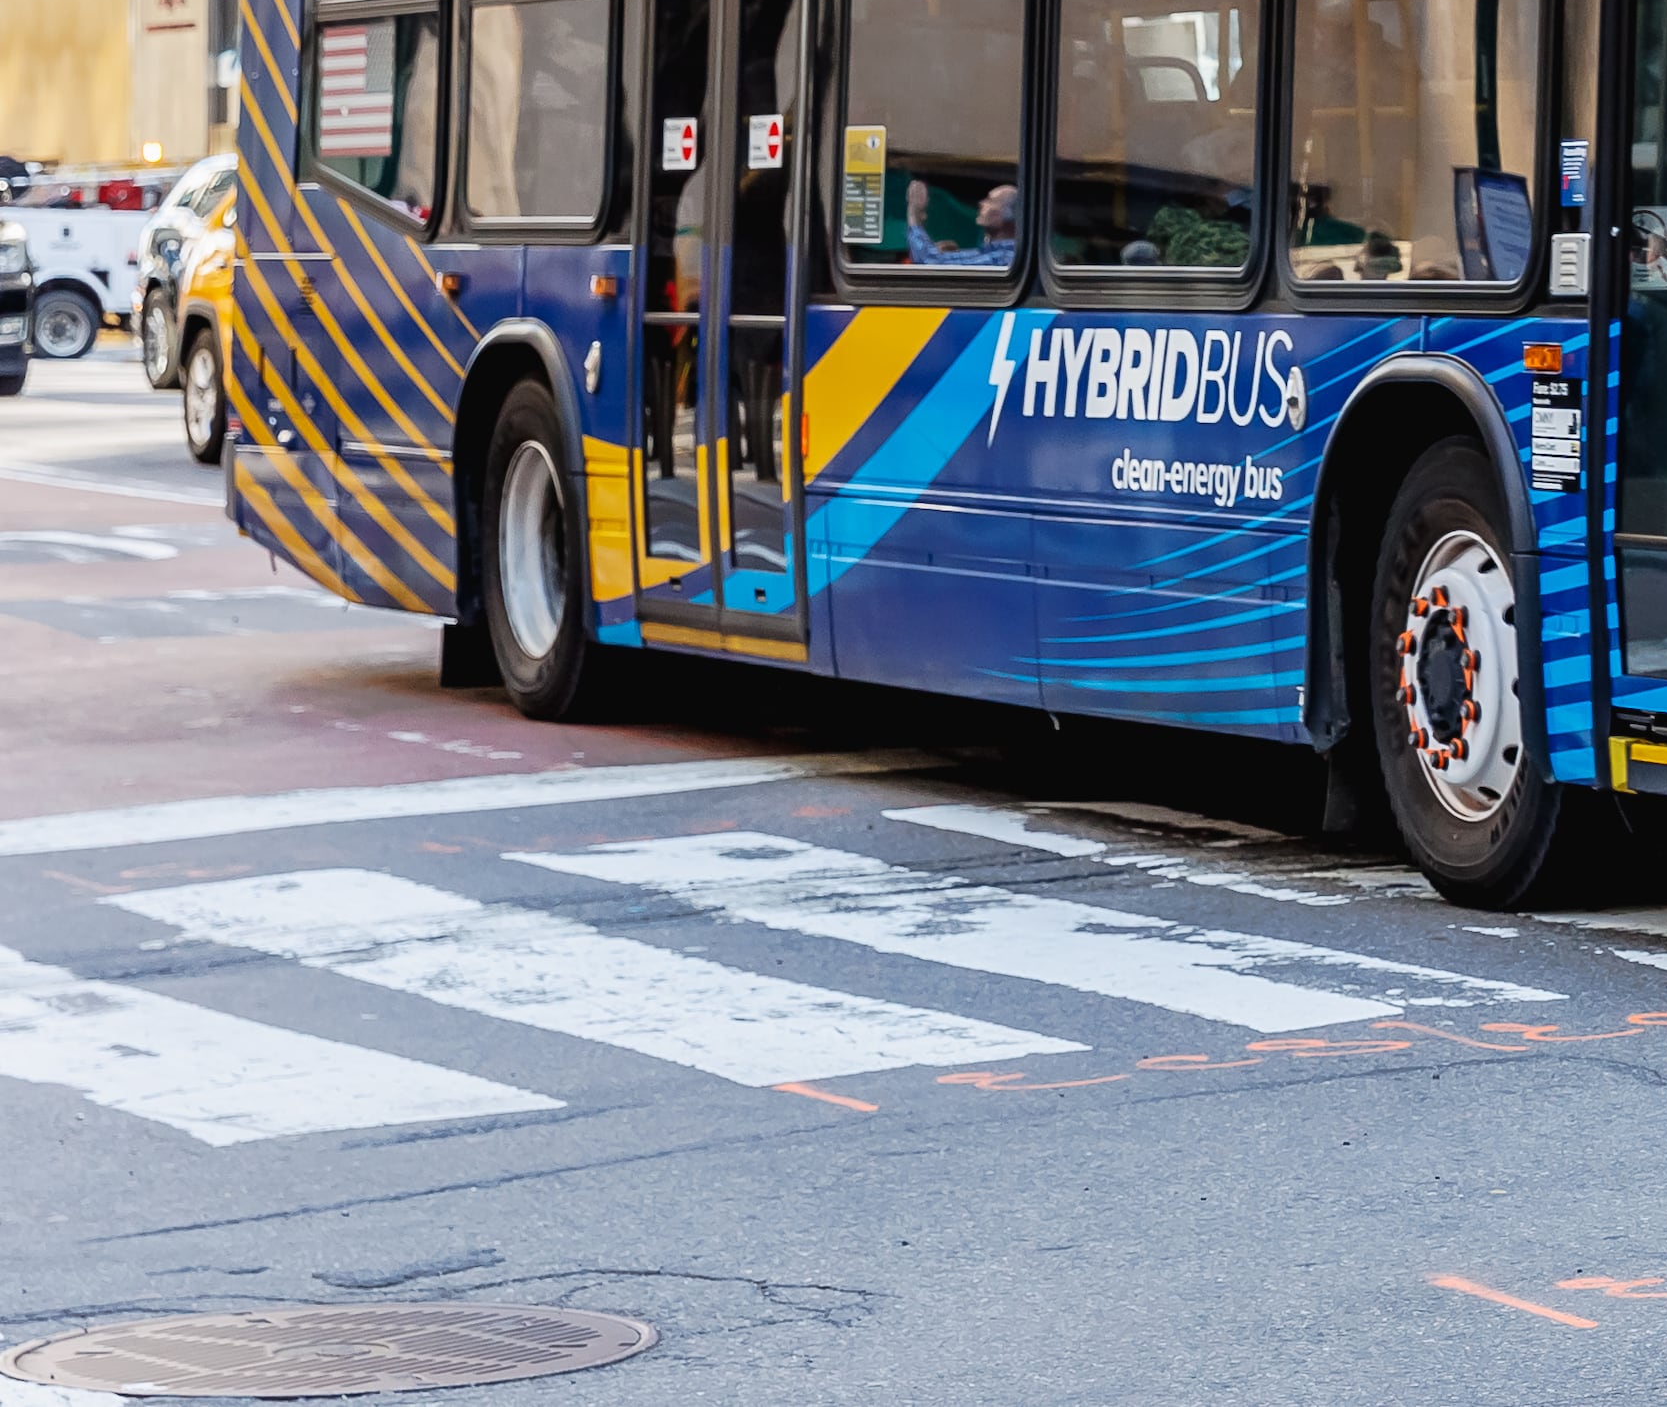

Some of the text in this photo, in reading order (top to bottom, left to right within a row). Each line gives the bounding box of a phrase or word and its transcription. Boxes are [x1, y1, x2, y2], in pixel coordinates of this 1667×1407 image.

[1023, 327, 1294, 428] HYBRIDBUS
[1111, 447, 1283, 508] clean-energy bus
